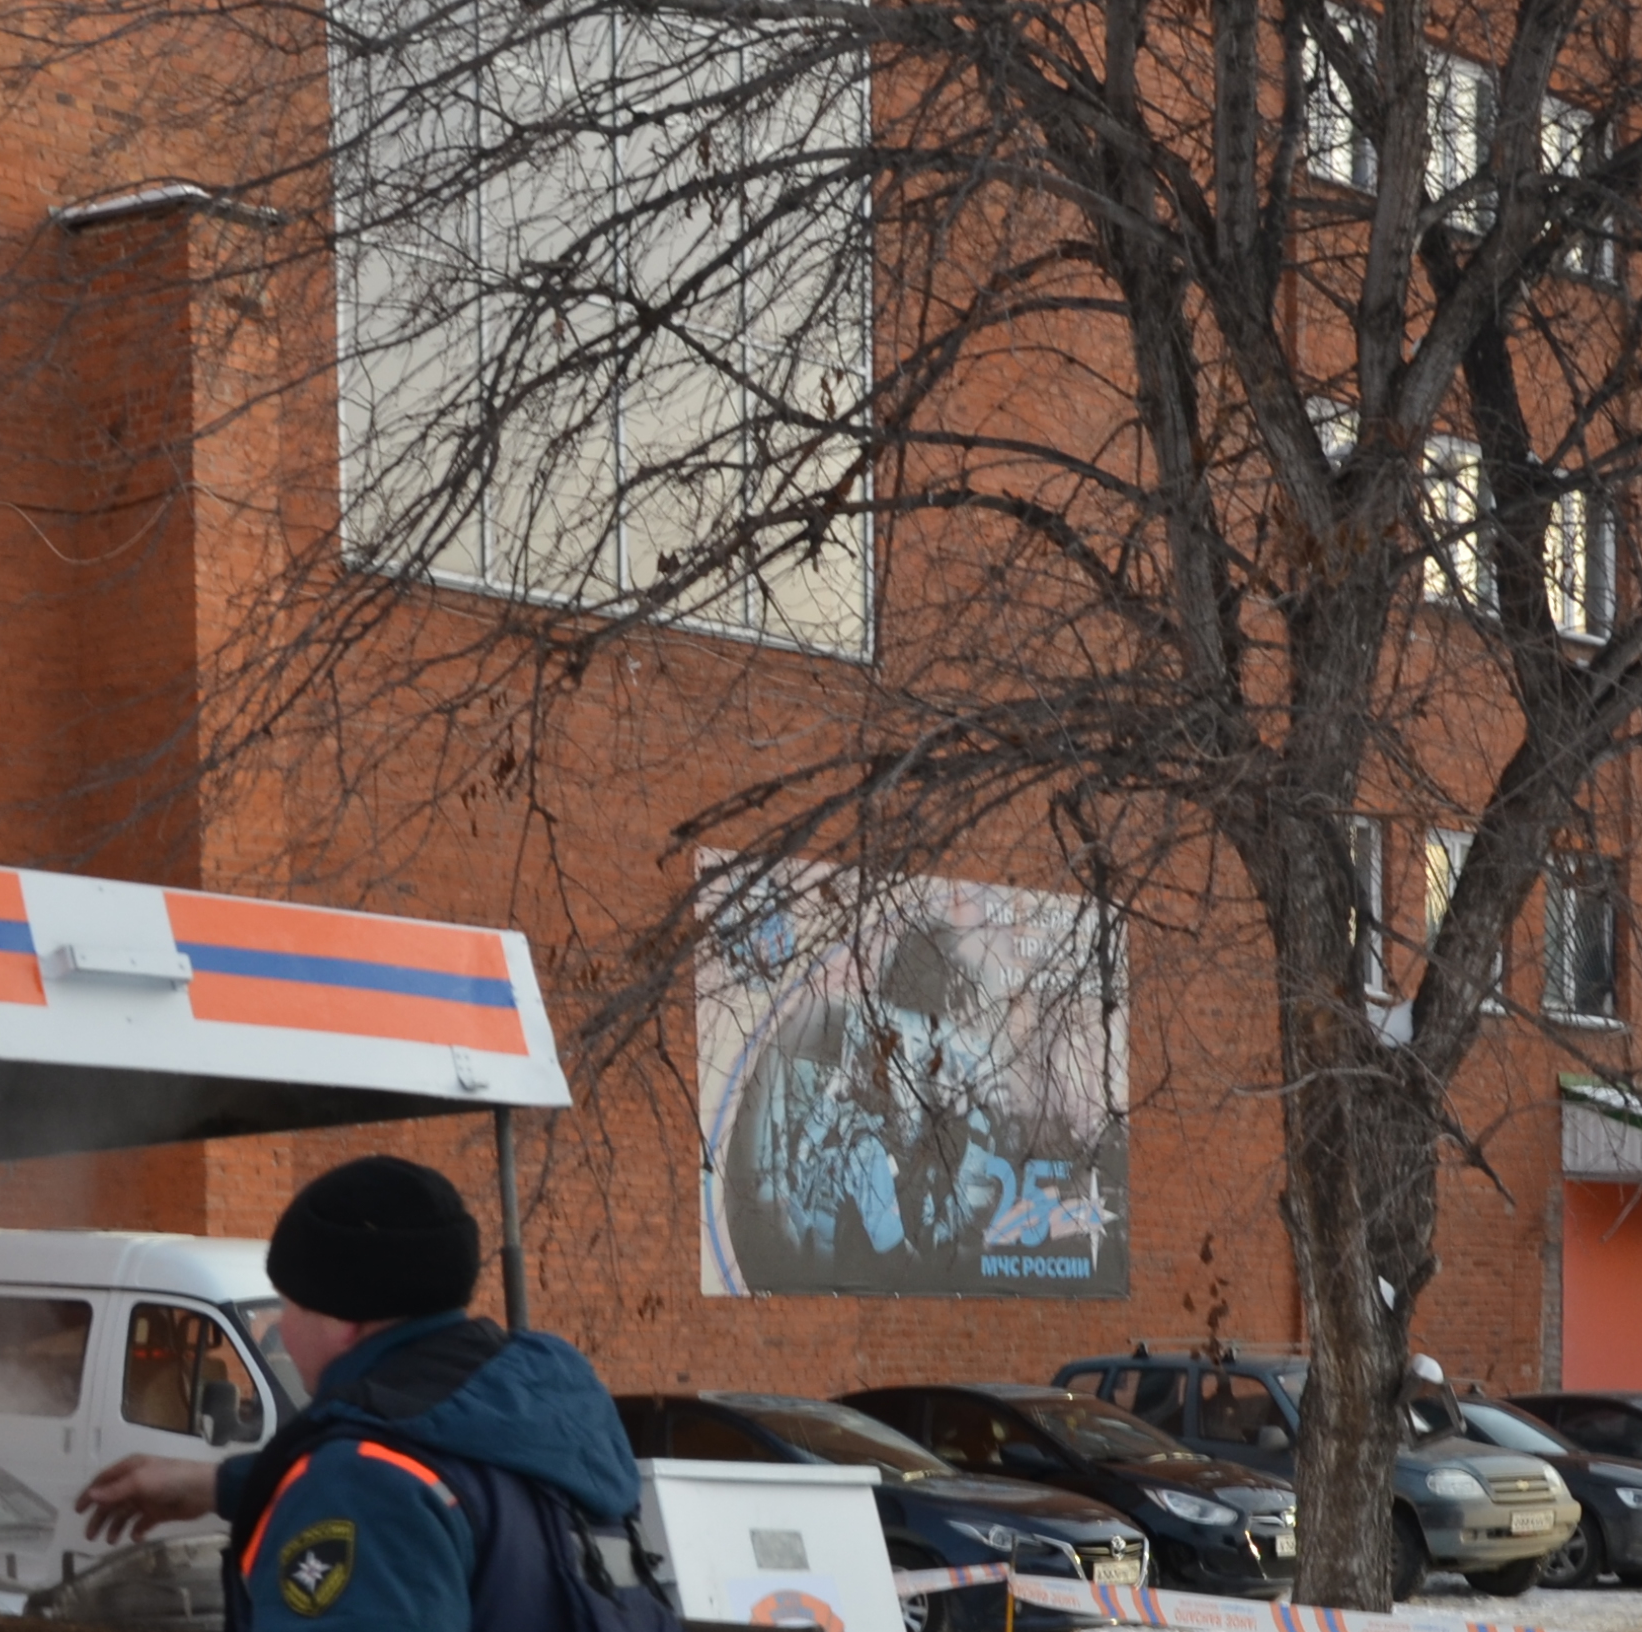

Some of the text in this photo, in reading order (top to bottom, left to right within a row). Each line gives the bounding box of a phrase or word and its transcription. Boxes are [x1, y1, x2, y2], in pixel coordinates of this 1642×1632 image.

[986, 1156, 1051, 1247] 25
[981, 1255, 1090, 1279] МЧС РОССИИ
